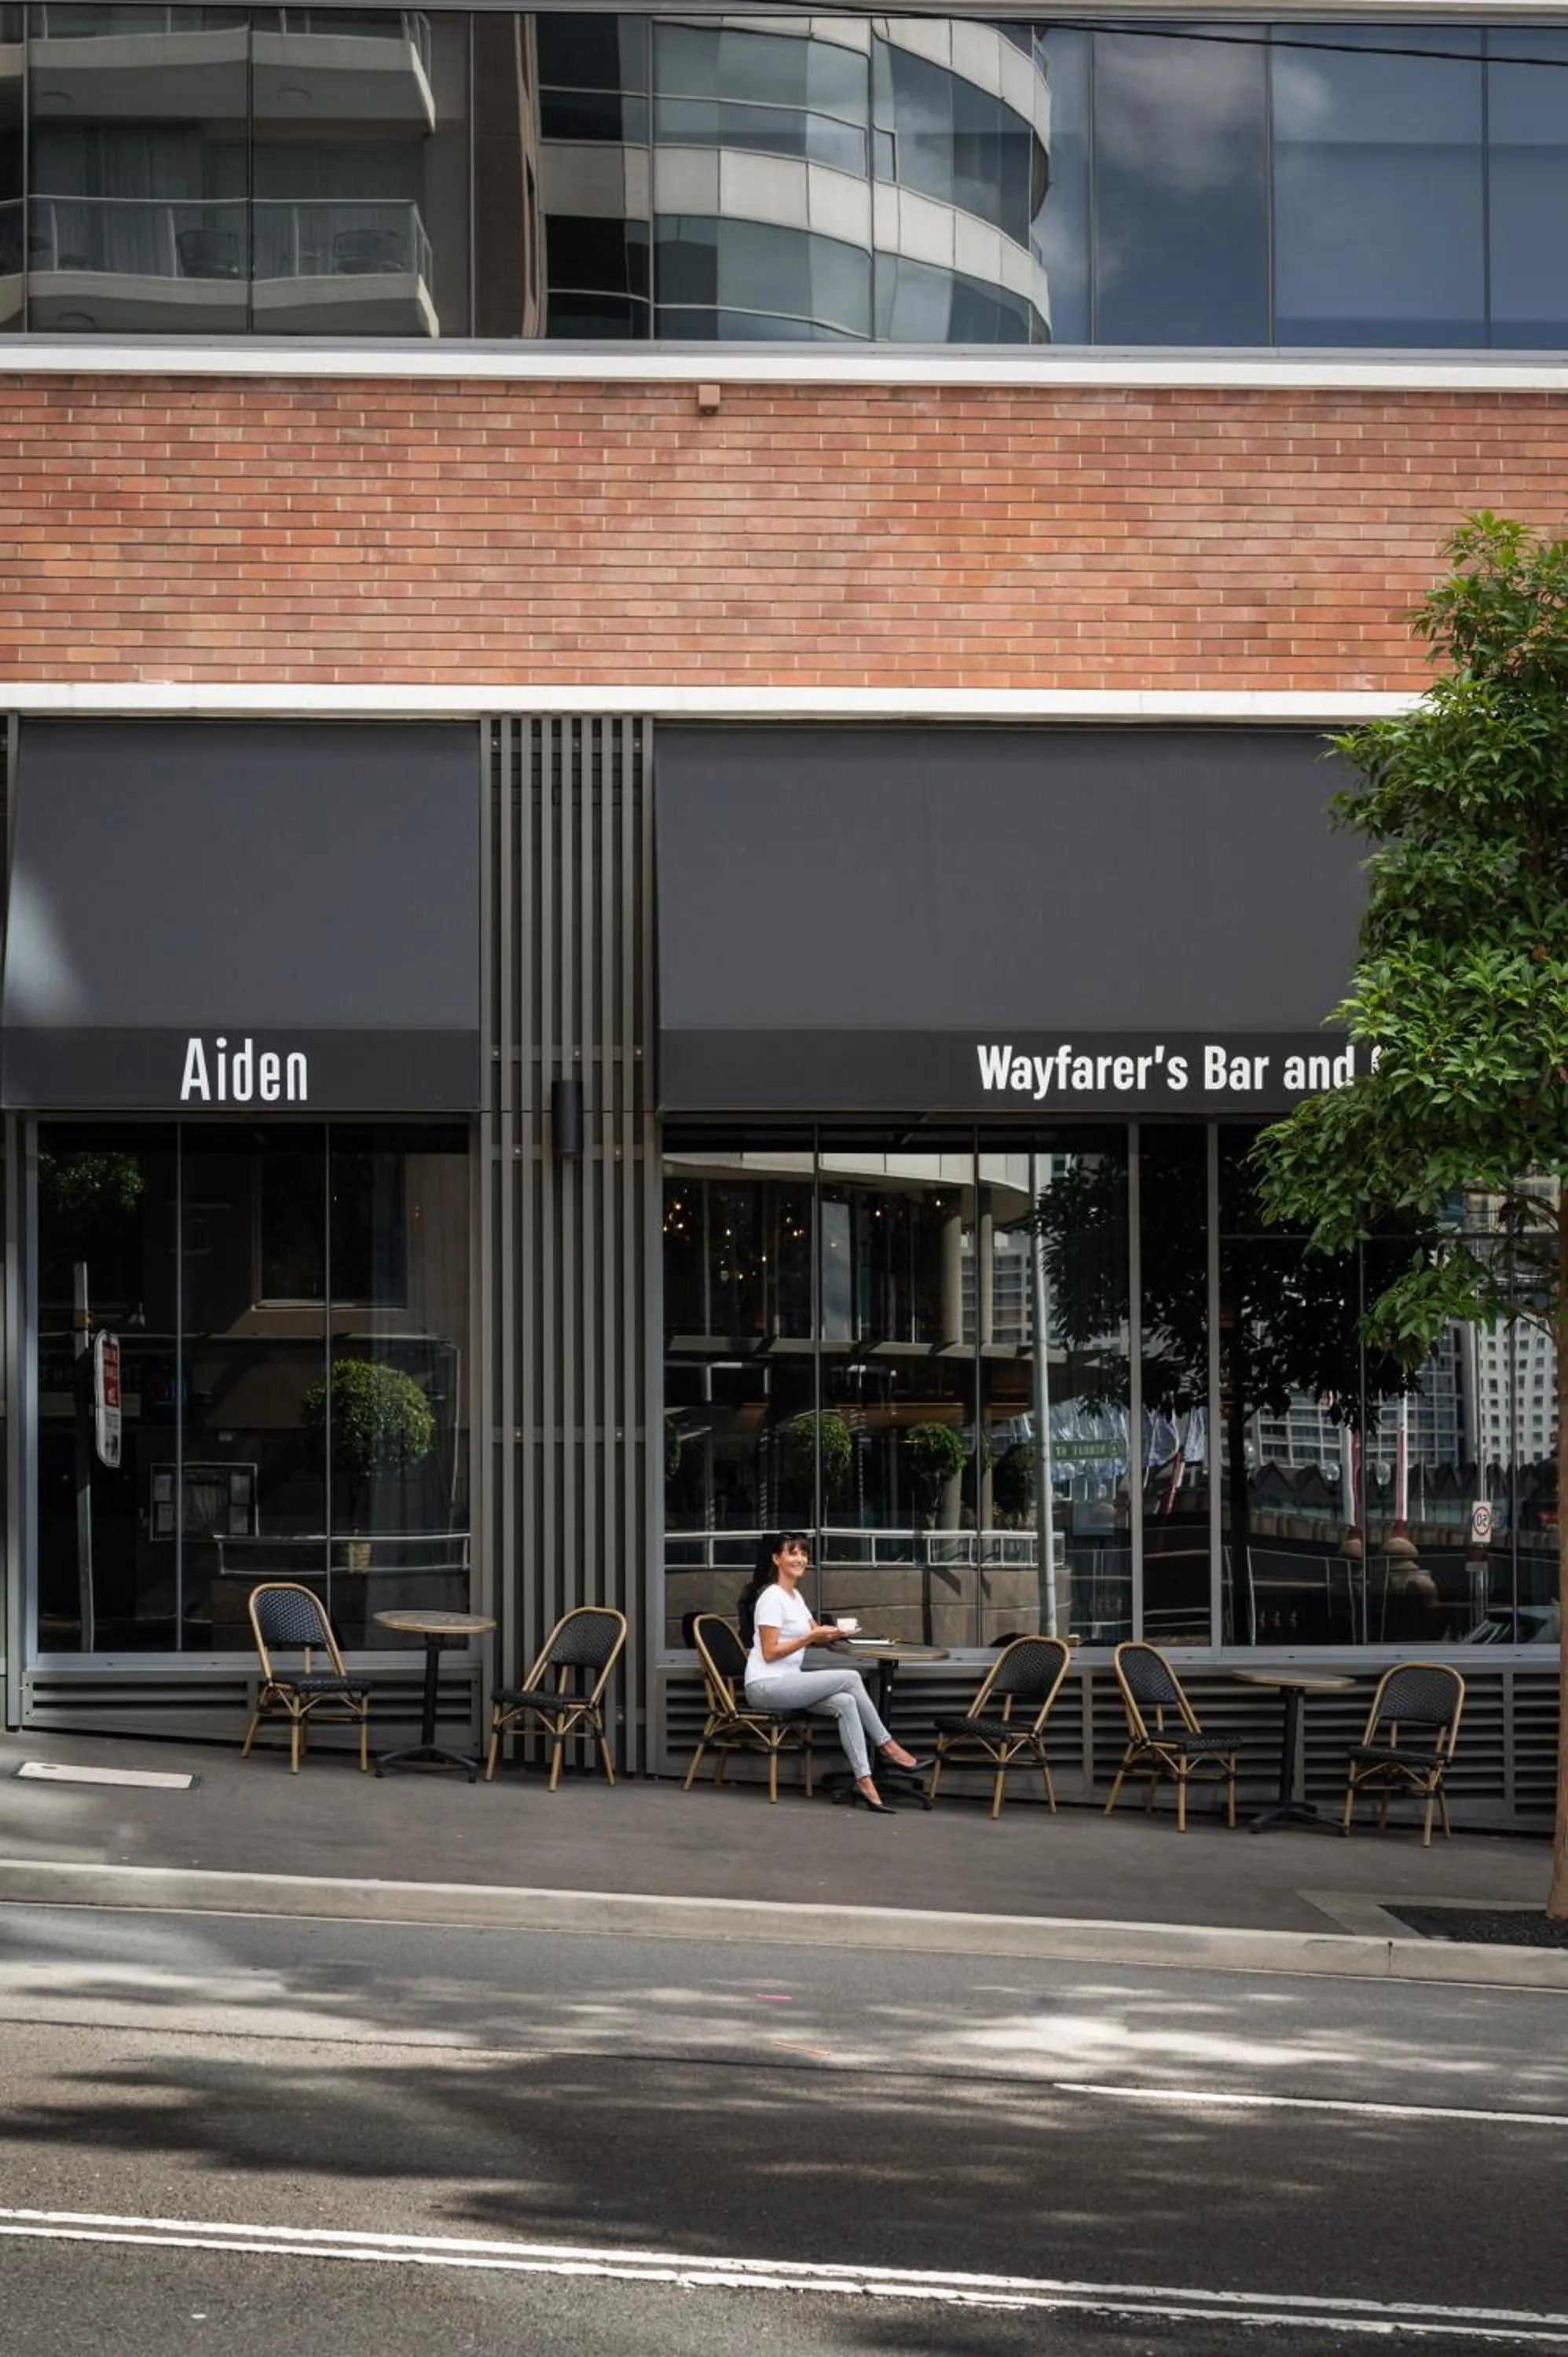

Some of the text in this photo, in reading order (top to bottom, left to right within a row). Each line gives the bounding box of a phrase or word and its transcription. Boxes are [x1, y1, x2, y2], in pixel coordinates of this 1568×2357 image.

[180, 1036, 308, 1102] Aiden
[976, 1044, 1189, 1100] Wayfarer's
[1203, 1045, 1269, 1091] Bar
[1283, 1044, 1355, 1091] and
